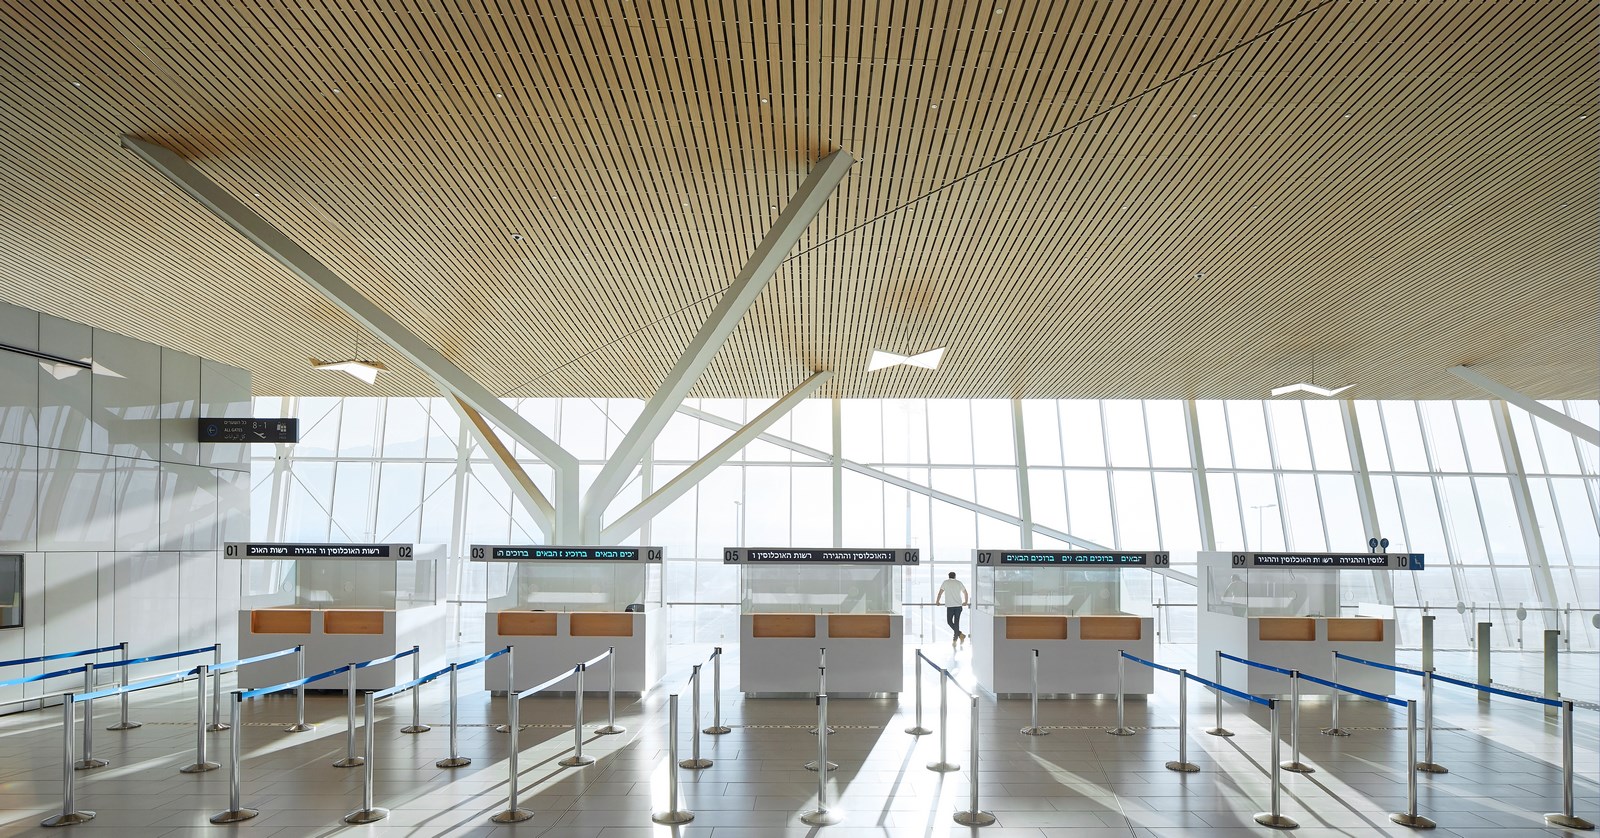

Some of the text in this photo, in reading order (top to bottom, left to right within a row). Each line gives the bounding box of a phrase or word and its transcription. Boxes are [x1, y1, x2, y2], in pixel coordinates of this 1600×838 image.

[226, 545, 238, 557] 01
[327, 547, 361, 556] האוכלוסין
[398, 546, 412, 558] 02
[472, 547, 485, 559] 03
[647, 549, 662, 561] 04
[725, 550, 739, 562] 05
[758, 551, 792, 560] האוכלוסין
[852, 552, 887, 561] האוכלוסין
[904, 551, 918, 563] 06
[978, 552, 992, 564] 07
[1154, 554, 1168, 566] 08
[1233, 554, 1246, 566] 09
[1280, 555, 1312, 564] האוכלוסין
[1395, 555, 1408, 568] 10
